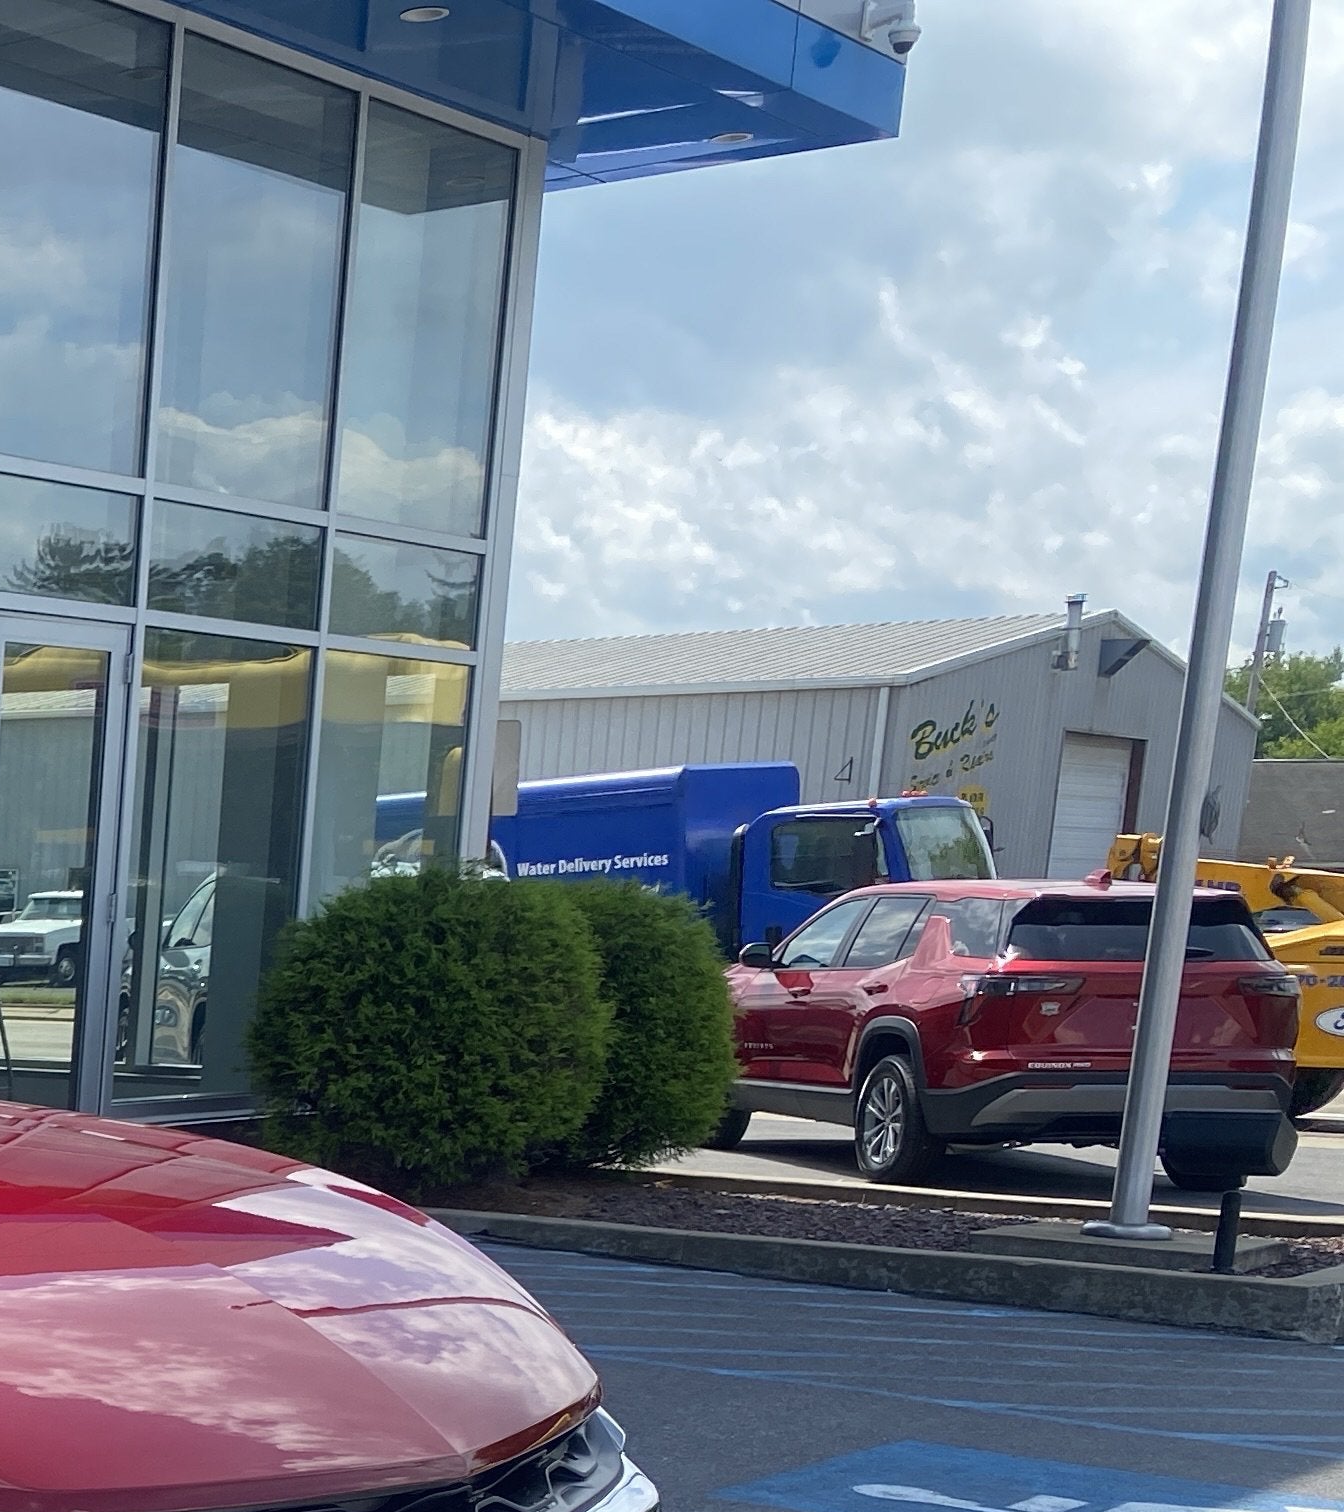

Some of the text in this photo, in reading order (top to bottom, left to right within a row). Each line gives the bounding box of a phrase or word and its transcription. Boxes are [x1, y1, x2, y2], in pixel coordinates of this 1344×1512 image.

[911, 699, 1000, 760] Buck's
[517, 852, 669, 877] Water Delivery Services
